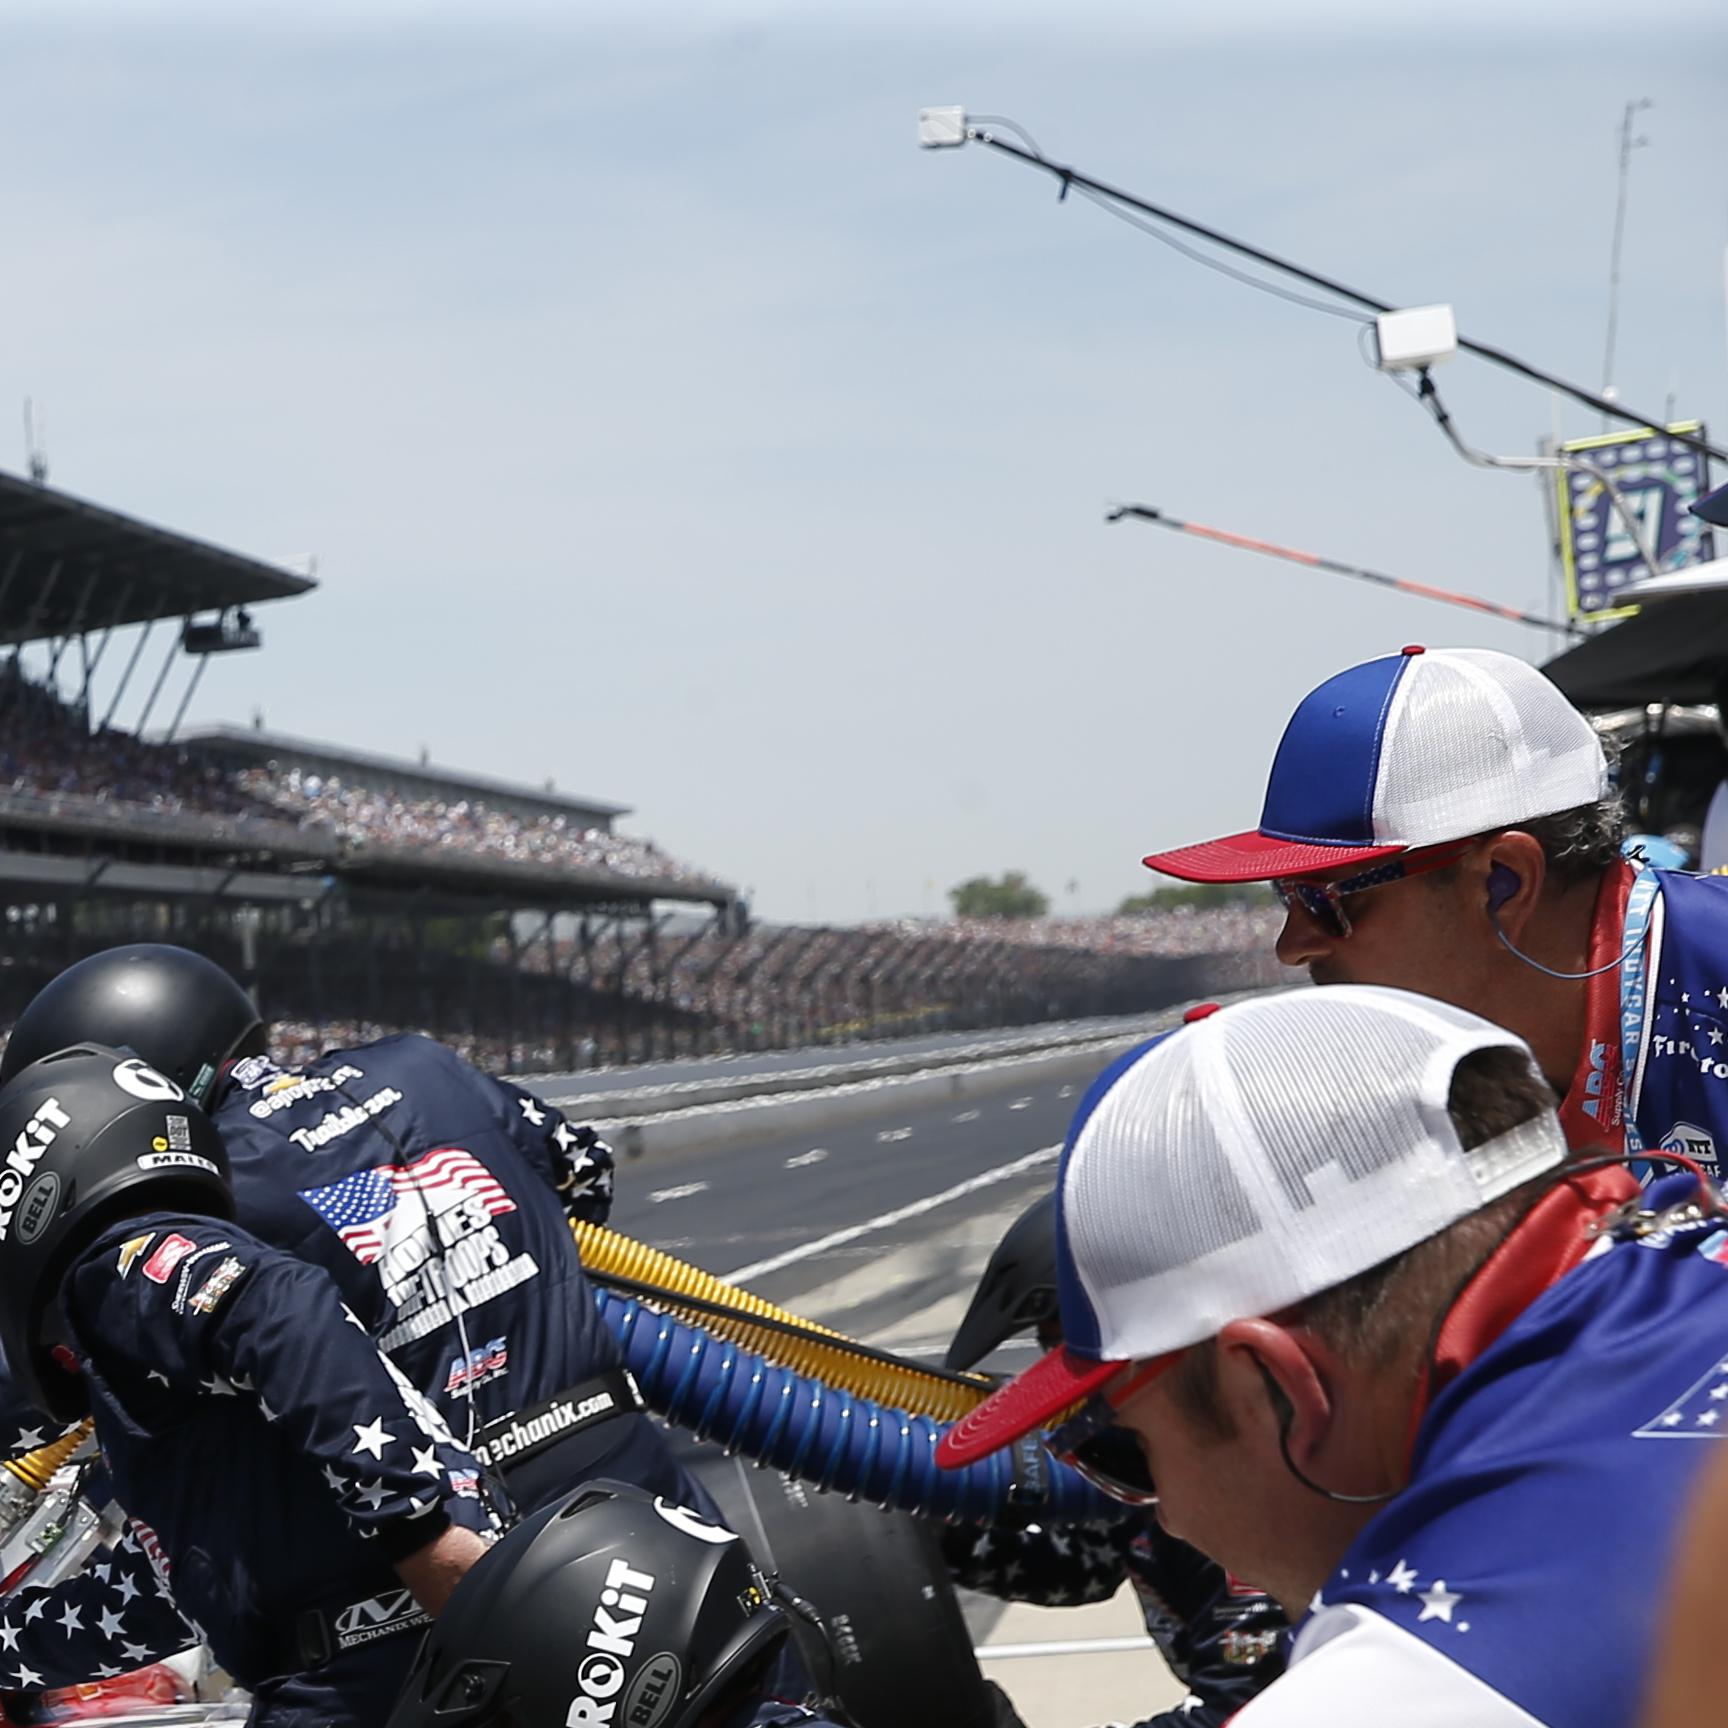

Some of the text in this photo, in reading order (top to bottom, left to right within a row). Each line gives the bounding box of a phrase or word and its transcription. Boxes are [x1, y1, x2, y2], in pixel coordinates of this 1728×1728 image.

[1686, 1138, 1712, 1155] NTT
[21, 1183, 54, 1235] BELL
[338, 1621, 409, 1650] MECHANIX
[629, 1667, 674, 1727] BELL
